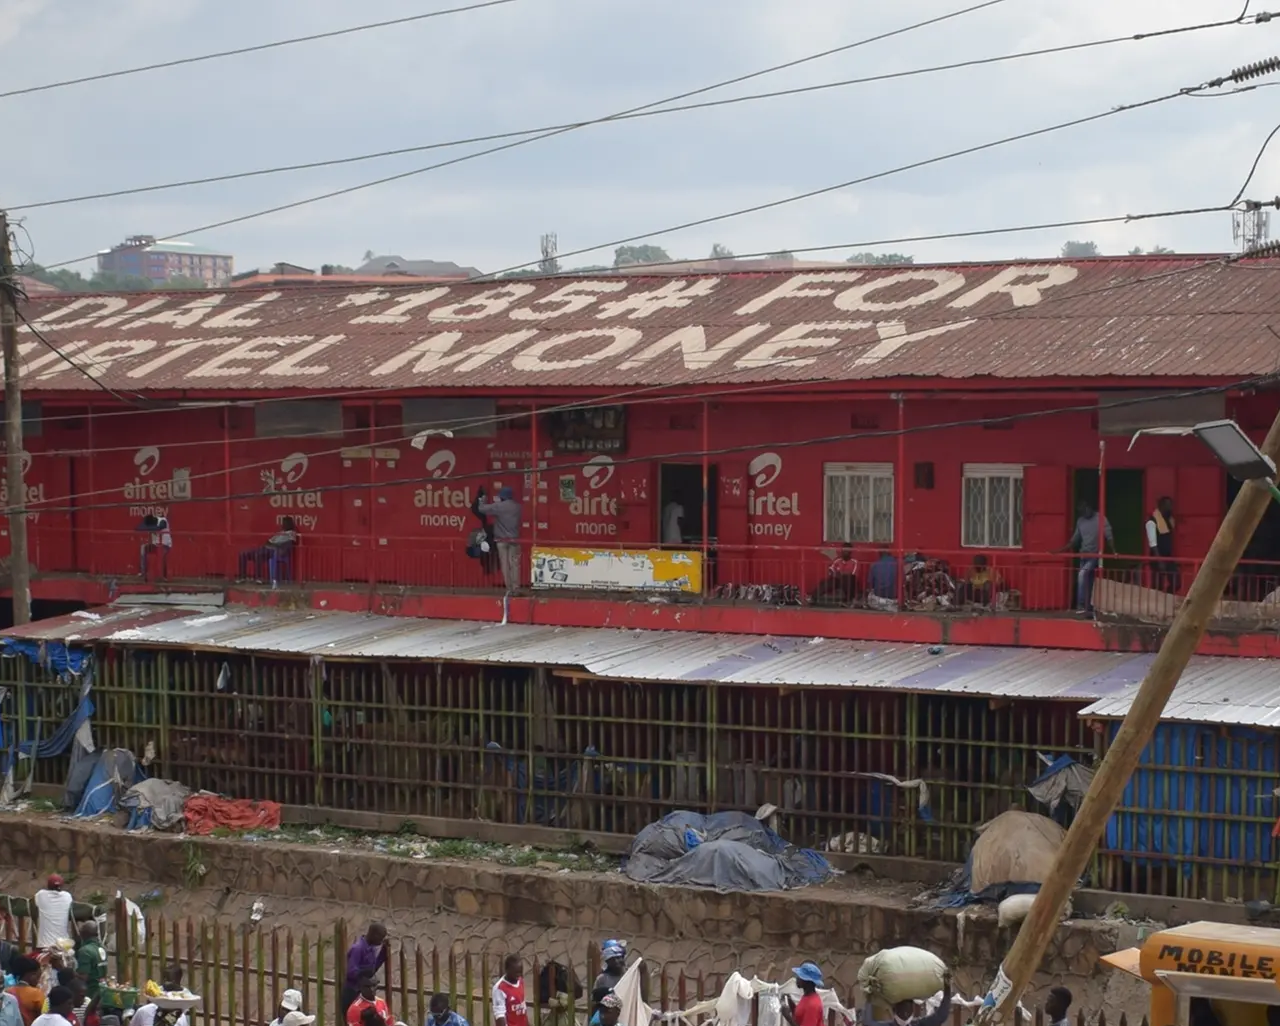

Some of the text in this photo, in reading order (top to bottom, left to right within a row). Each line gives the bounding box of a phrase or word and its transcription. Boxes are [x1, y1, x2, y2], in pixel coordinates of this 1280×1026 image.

[17, 292, 282, 332] DIAL
[735, 264, 1079, 316] FOR
[371, 318, 976, 376] MONEY
[0, 482, 45, 502] atel
[124, 479, 171, 500] airtel
[270, 486, 323, 508] airtel
[414, 484, 472, 508] airtel
[570, 490, 617, 516] airte
[748, 489, 800, 516] irtel
[421, 514, 467, 531] money
[575, 521, 617, 535] mone
[1157, 944, 1275, 972] MOBILE
